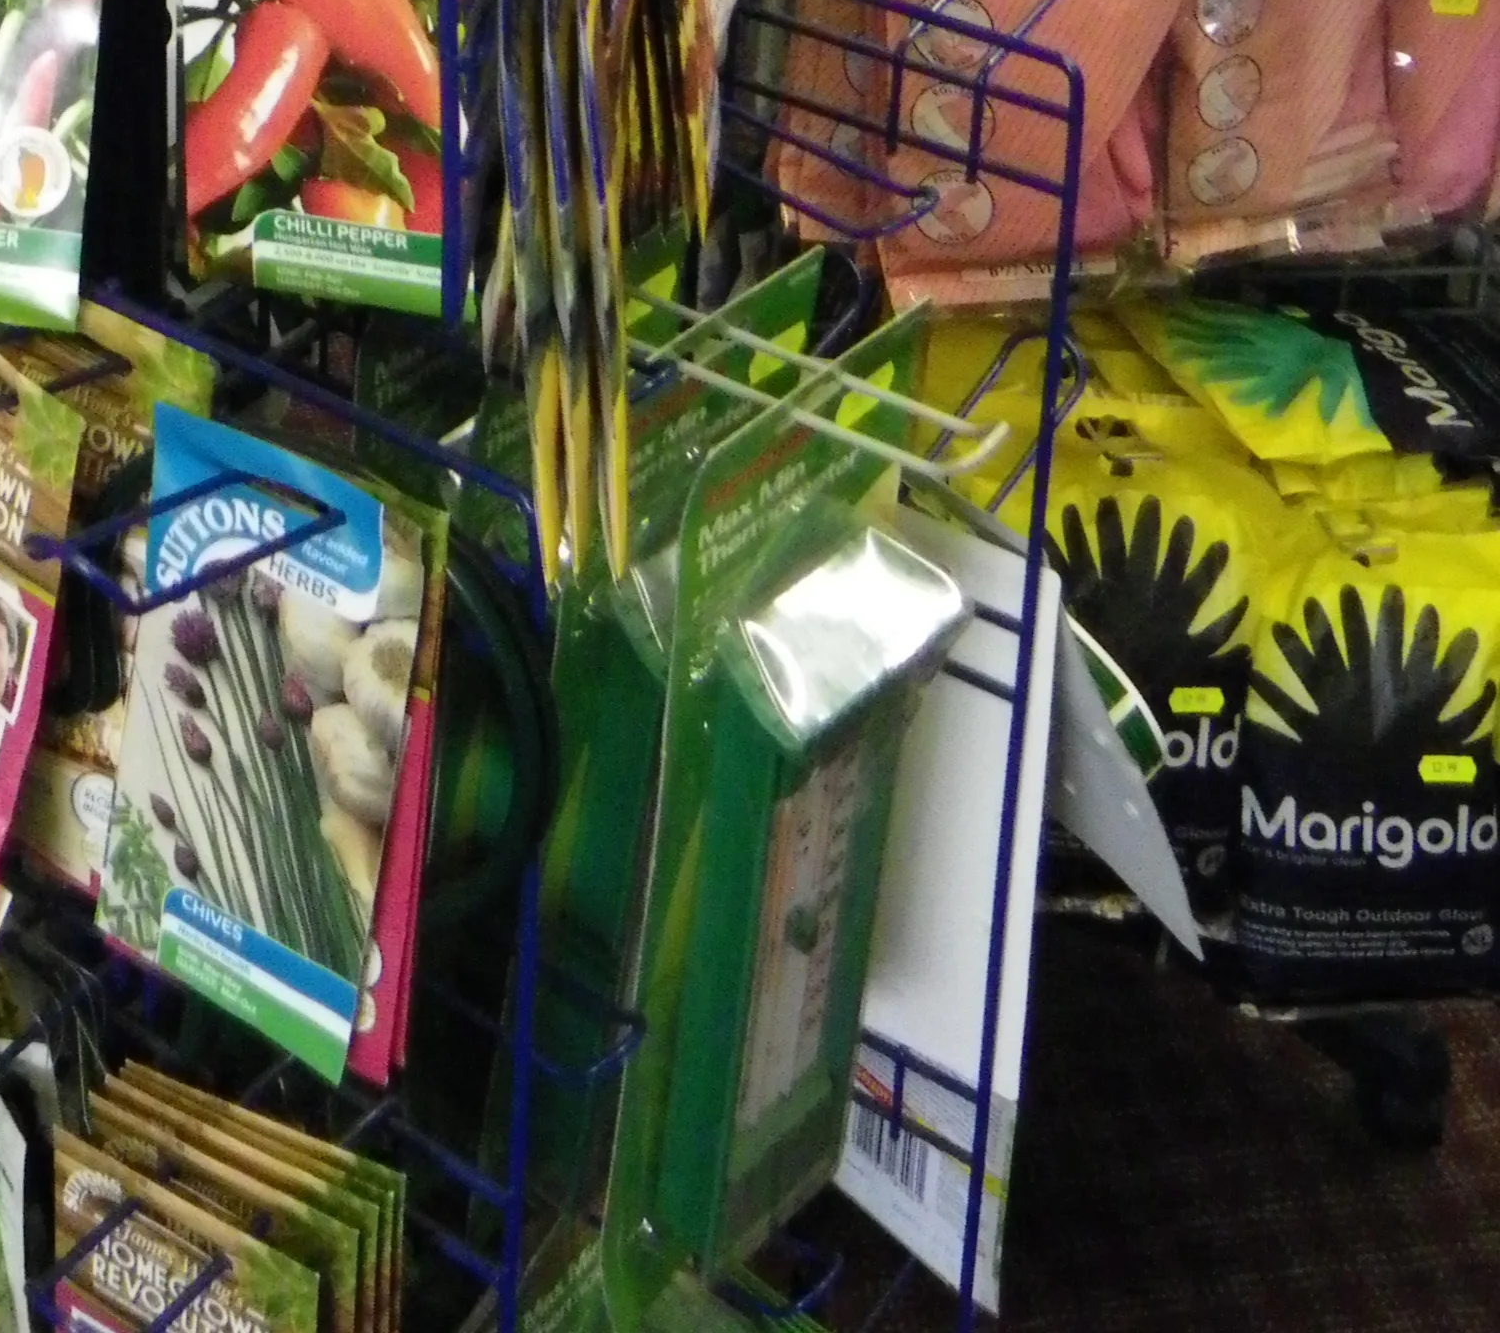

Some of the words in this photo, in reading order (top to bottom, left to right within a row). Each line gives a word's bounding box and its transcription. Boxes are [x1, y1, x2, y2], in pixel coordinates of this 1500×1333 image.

[273, 214, 333, 238] CHILLI
[339, 224, 409, 251] PEPPER
[156, 497, 287, 591] SUTTONS
[299, 541, 349, 577] flavour
[269, 555, 339, 606] HERBS
[1241, 784, 1498, 870] Marigold
[181, 893, 243, 943] CHIVES
[1292, 905, 1351, 925] Tough
[1355, 908, 1432, 924] Outdoor
